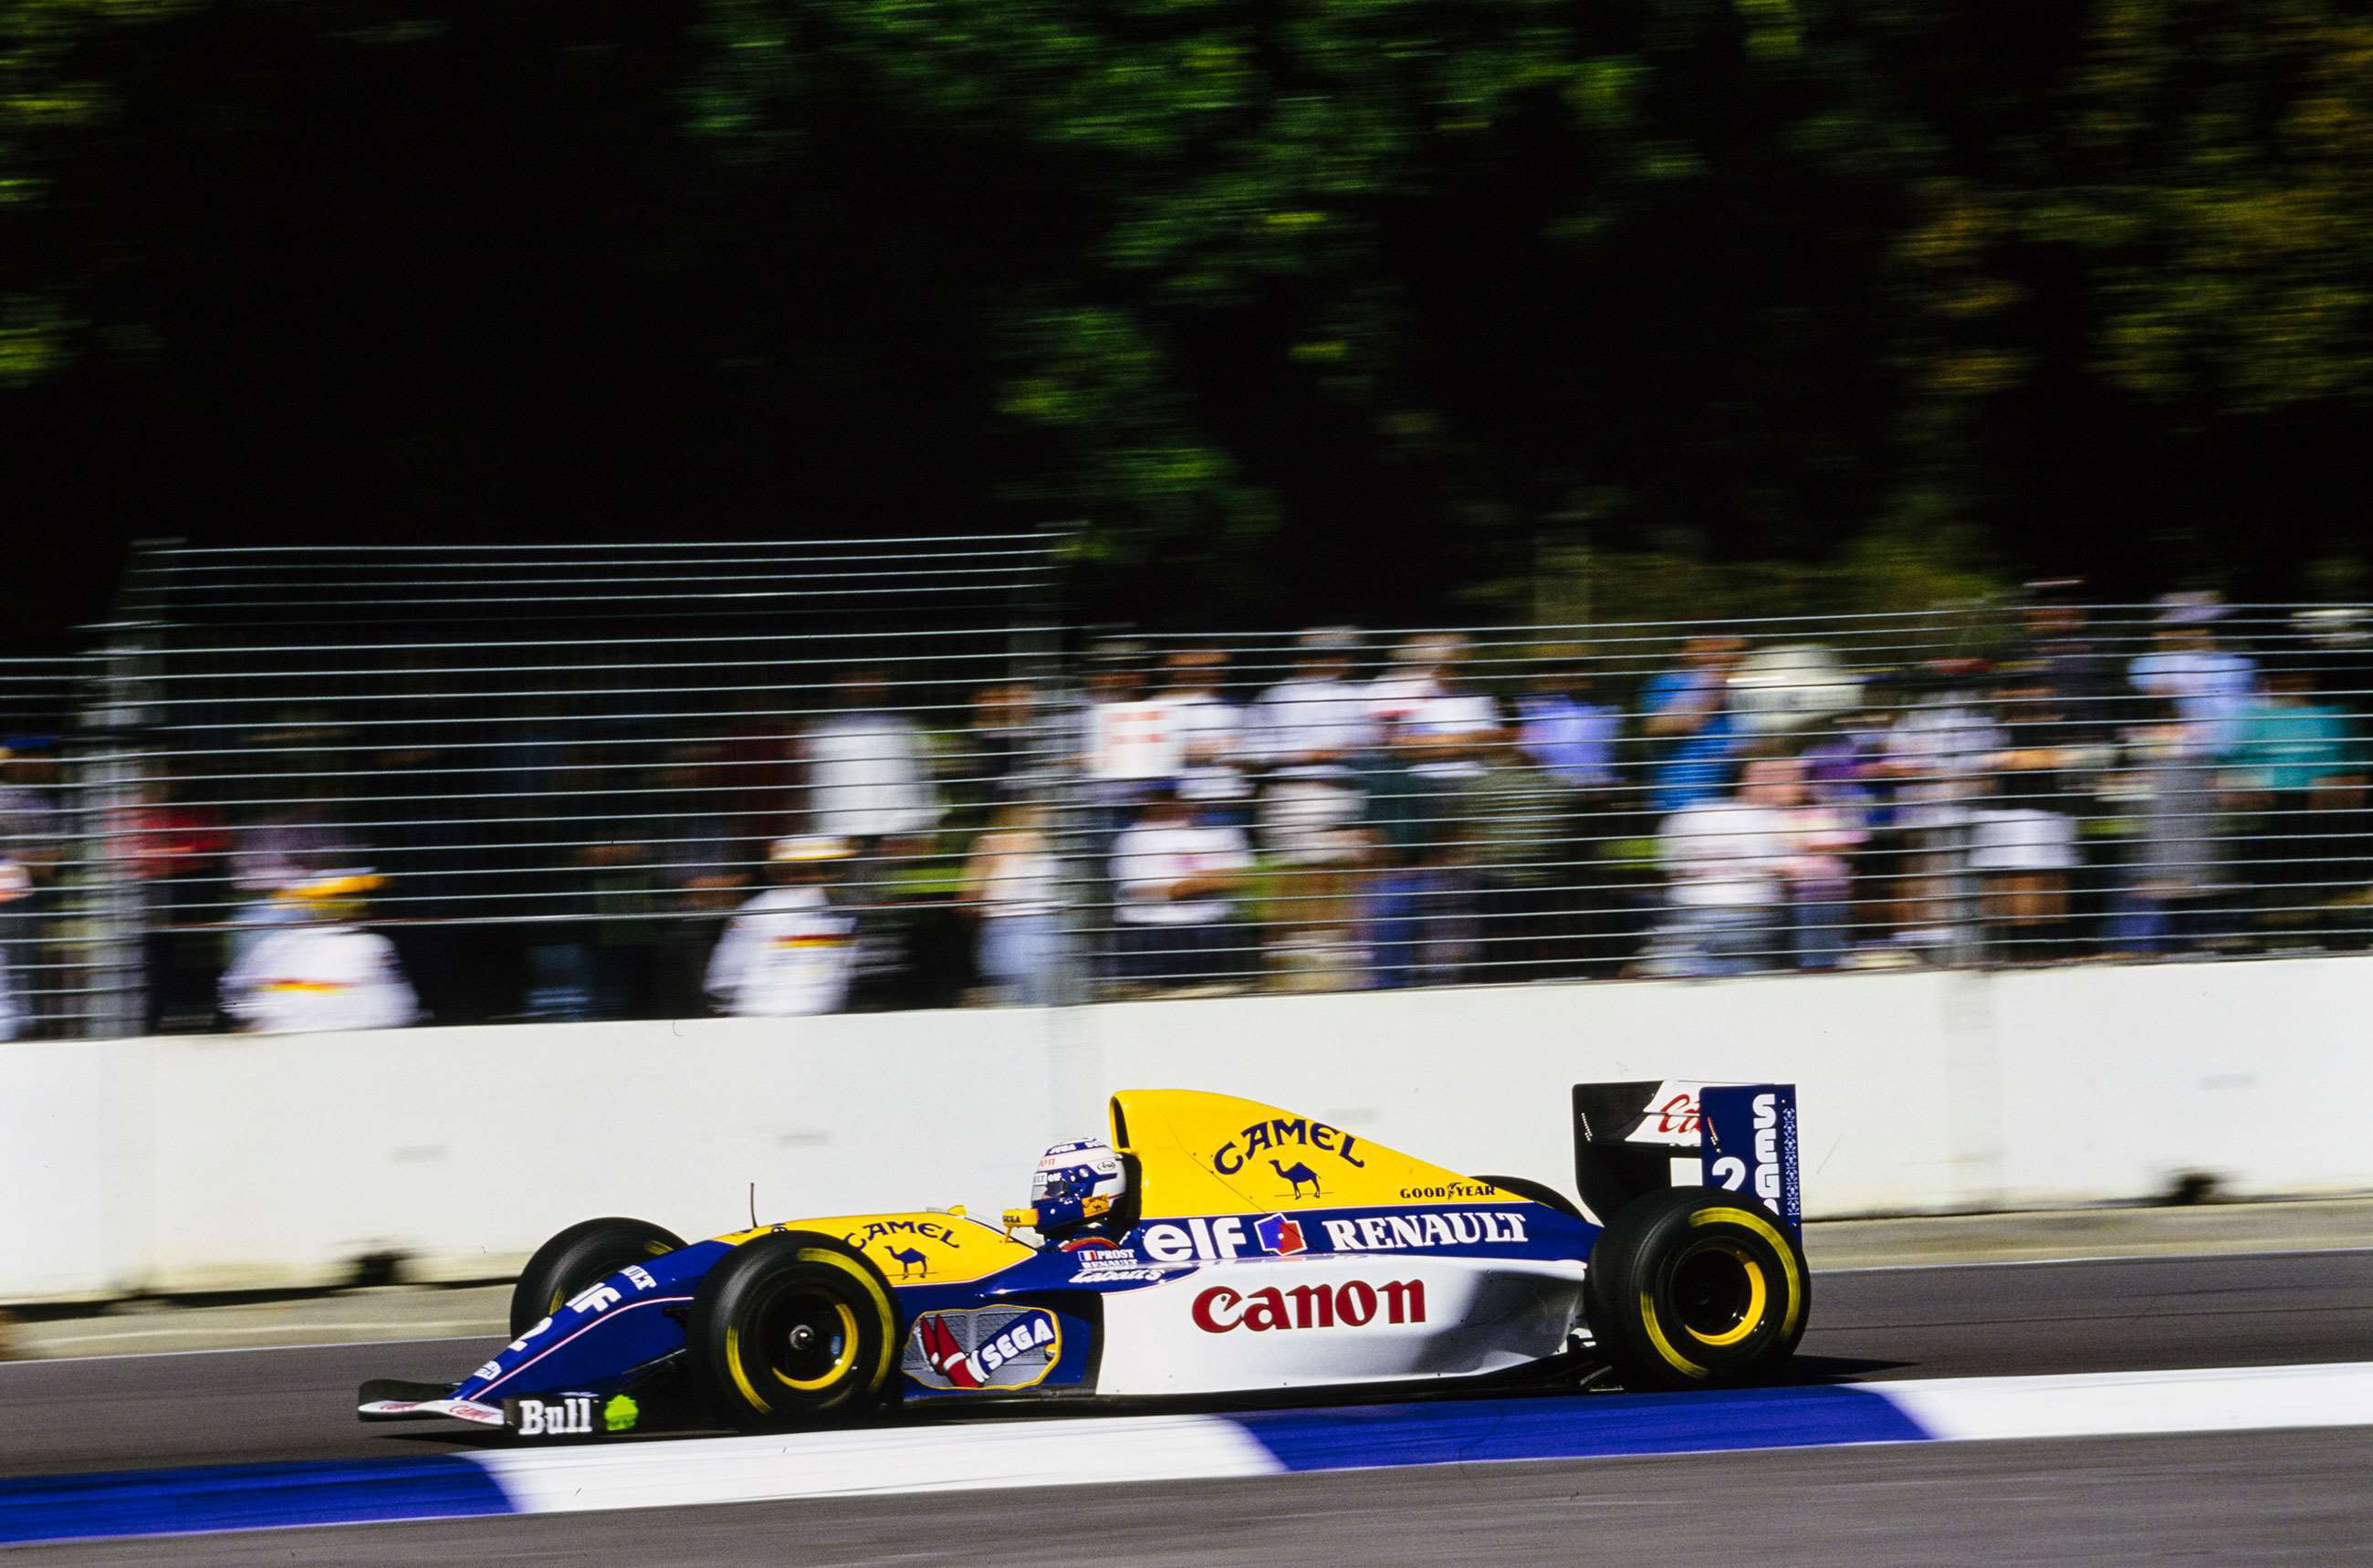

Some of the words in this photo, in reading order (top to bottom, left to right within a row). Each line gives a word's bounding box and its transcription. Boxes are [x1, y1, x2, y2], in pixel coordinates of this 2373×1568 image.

[1214, 1118, 1364, 1176] CAMEL
[843, 1220, 960, 1252] CAMEL
[1143, 1216, 1248, 1262] elf
[1322, 1211, 1529, 1253] RENAULT
[1097, 1249, 1135, 1260] PROST
[1191, 1278, 1426, 1333] Canon
[981, 1318, 1054, 1371] SEGA
[517, 1398, 592, 1436] Bull
